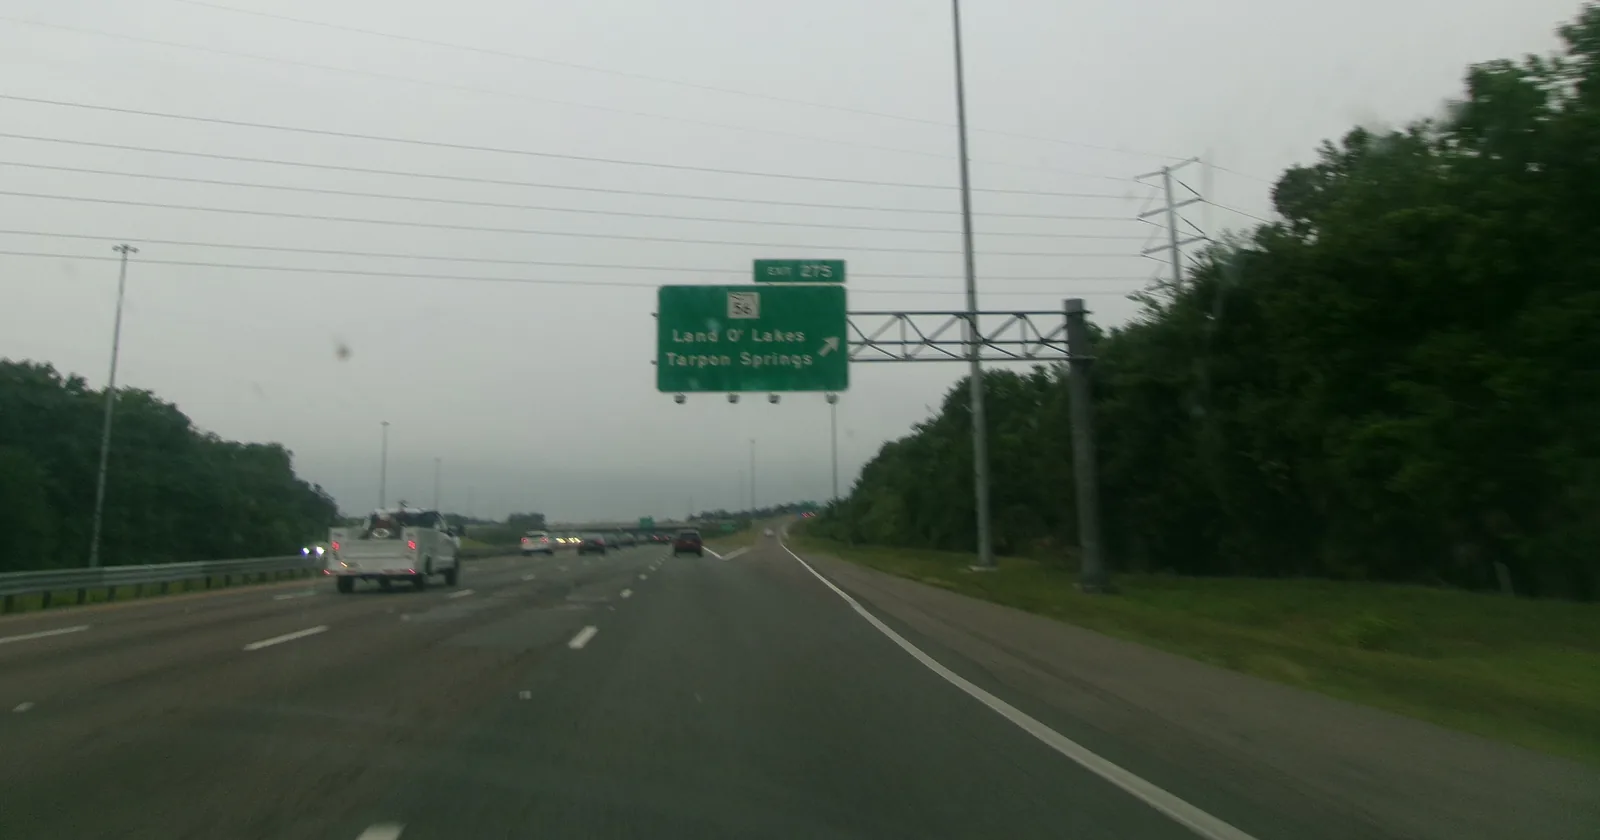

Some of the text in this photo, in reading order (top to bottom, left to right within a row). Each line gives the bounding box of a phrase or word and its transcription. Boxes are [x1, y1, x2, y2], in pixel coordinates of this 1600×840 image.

[800, 265, 832, 278] 275
[733, 302, 753, 314] 56
[672, 328, 806, 342] Land O' Lakes
[665, 351, 813, 368] Tarpon Springs
